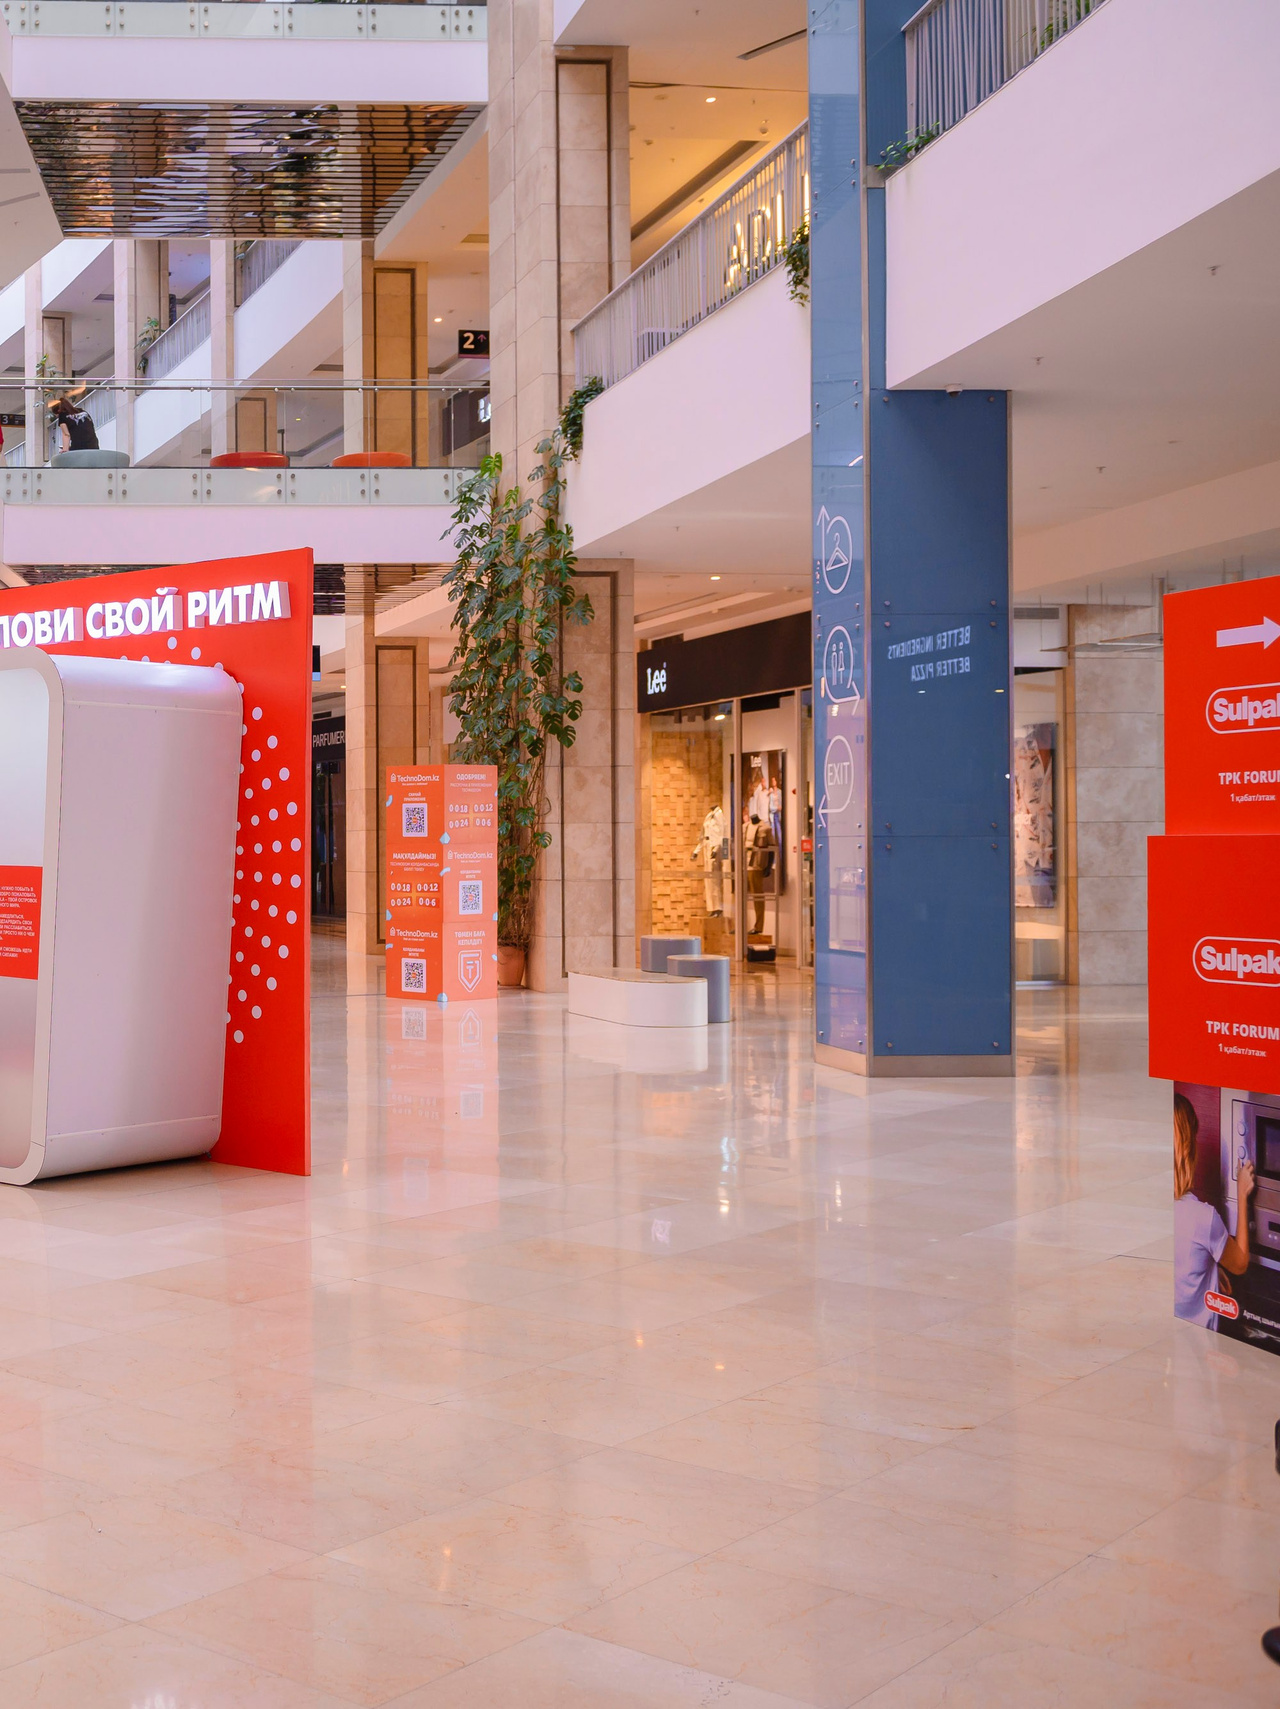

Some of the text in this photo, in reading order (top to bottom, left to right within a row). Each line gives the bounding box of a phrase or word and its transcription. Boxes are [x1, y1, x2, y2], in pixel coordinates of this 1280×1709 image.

[462, 332, 475, 349] 2
[2, 415, 8, 424] 3
[86, 587, 179, 639] СВОЙ
[187, 580, 285, 629] РИТМ
[646, 667, 667, 695] Lee
[397, 773, 440, 782] TechnoDom.kz
[827, 761, 851, 786] EXIT
[1218, 772, 1241, 785] TPK
[1231, 793, 1276, 803] 1 қабат/этаж
[453, 851, 493, 859] TechnoDom.kz
[396, 929, 439, 938] TechnoDom.kz
[1200, 945, 1280, 979] Sulpak
[1206, 1020, 1280, 1041] TPK FORUM
[1218, 1043, 1267, 1057] 1 қабат/этаж
[1206, 1294, 1236, 1314] Sulpak
